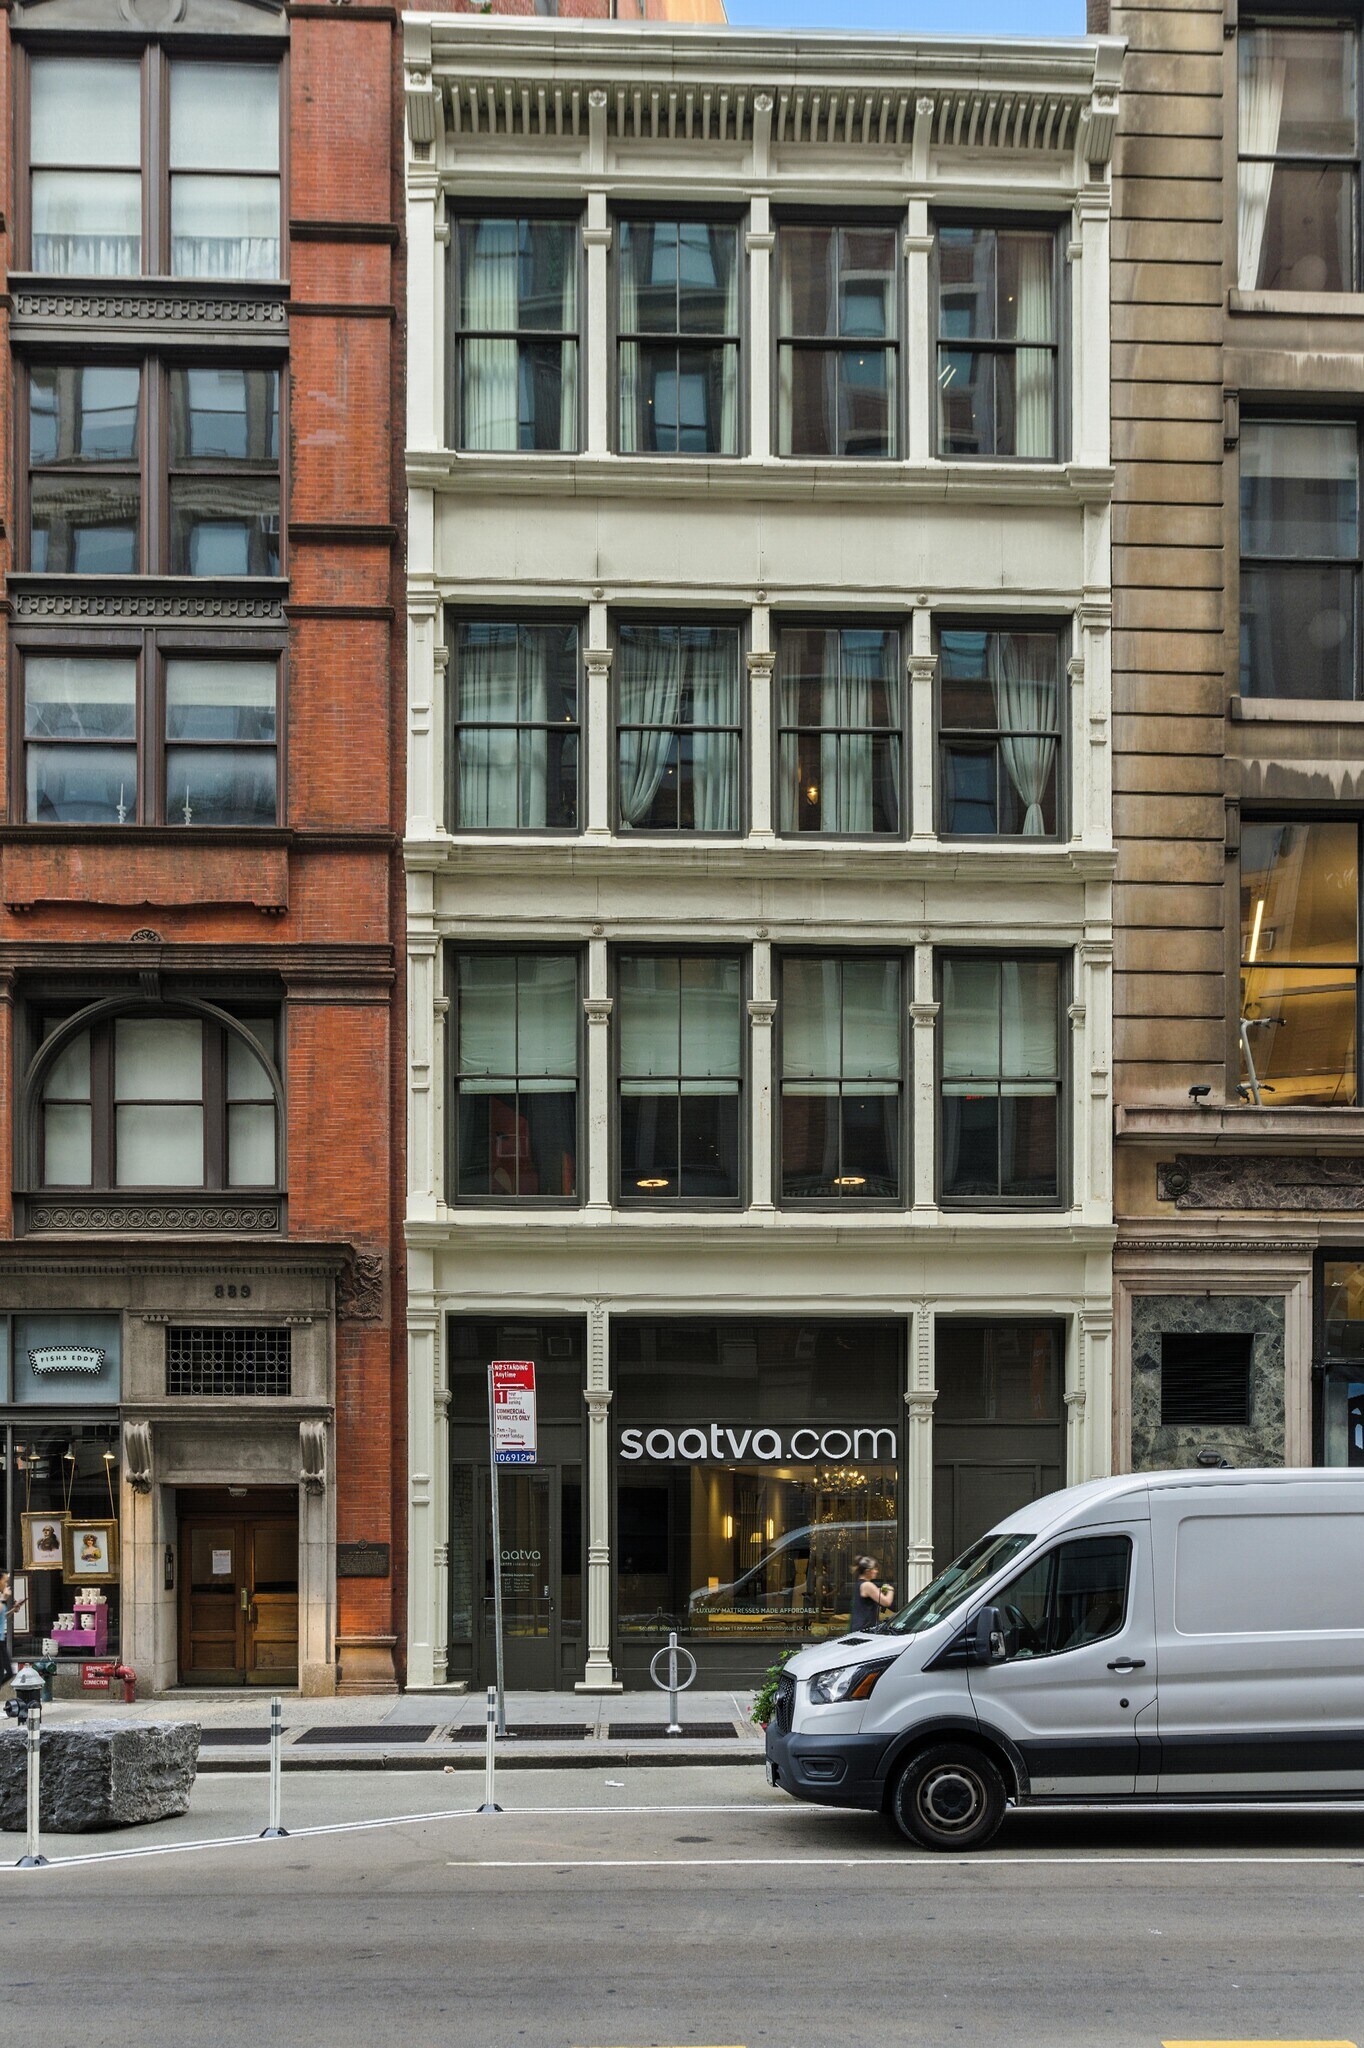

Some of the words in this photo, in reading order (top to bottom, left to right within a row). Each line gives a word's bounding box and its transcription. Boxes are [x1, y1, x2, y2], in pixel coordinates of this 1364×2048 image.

[40, 1355, 67, 1363] FISHS
[495, 1371, 517, 1379] Anytime
[499, 1391, 504, 1403] 1
[620, 1424, 896, 1459] saatva.com
[495, 1453, 526, 1462] 106912
[500, 1549, 541, 1560] aatva
